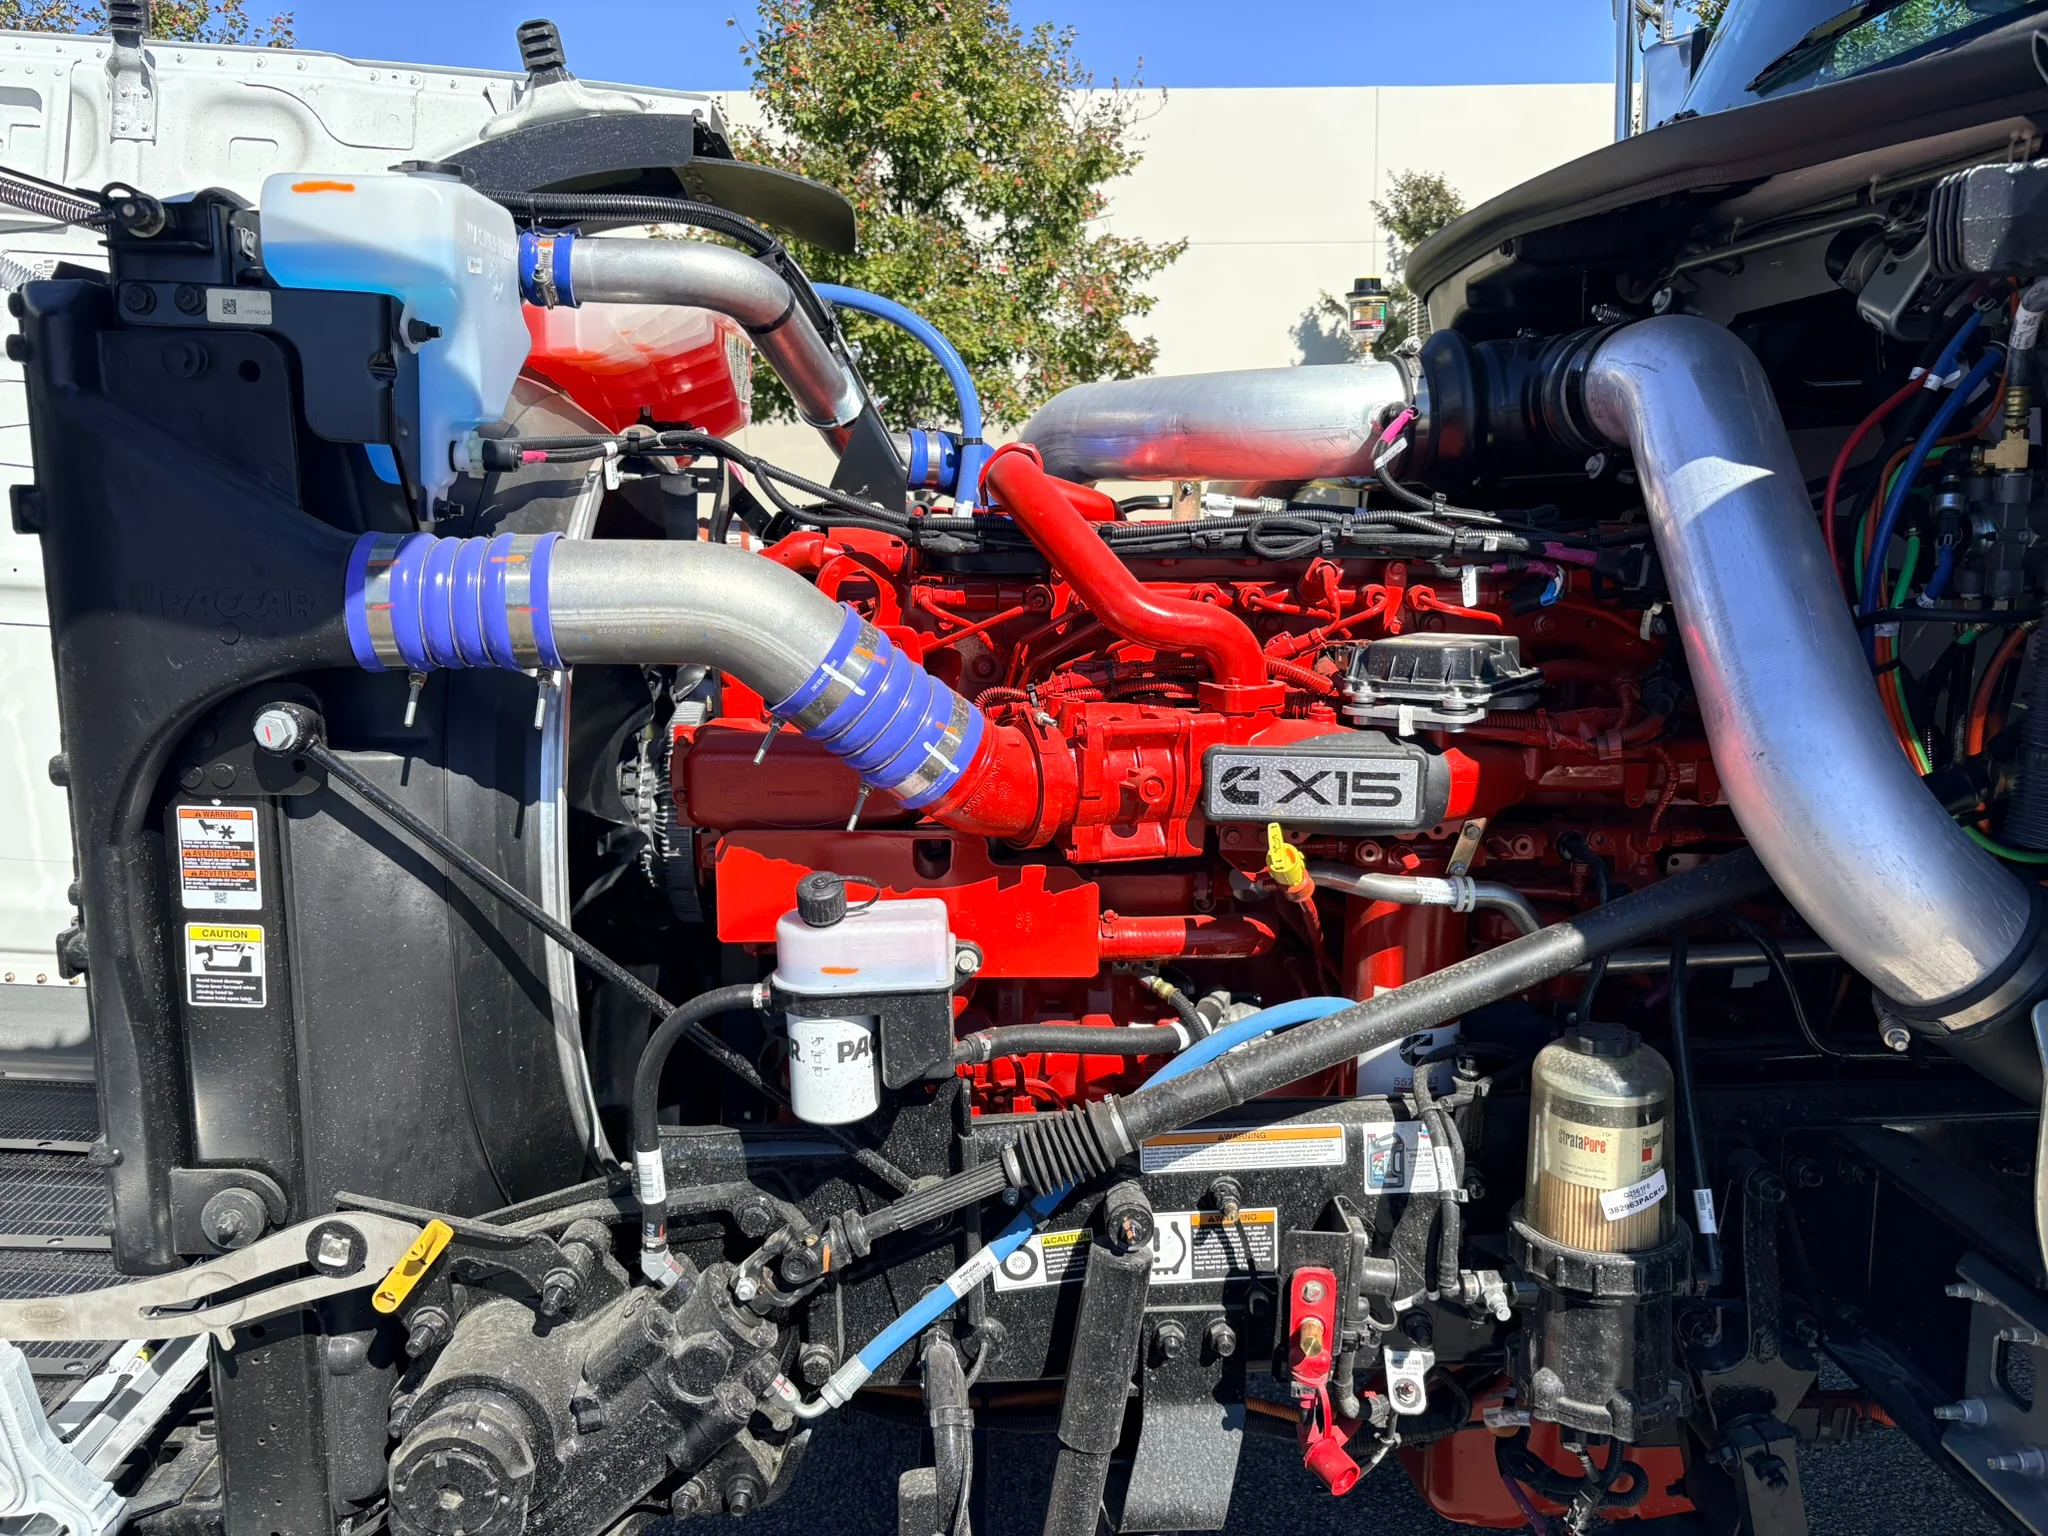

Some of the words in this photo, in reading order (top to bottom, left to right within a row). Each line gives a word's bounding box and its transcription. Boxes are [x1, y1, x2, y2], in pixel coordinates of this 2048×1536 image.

[963, 790, 986, 815] MADE
[983, 781, 994, 792] IN
[990, 756, 1006, 781] INDIA
[1220, 766, 1259, 791] Cummins
[1275, 769, 1403, 807] X15
[203, 811, 239, 819] WARNING
[193, 850, 252, 858] AVERTISSEMENT
[199, 870, 249, 878] ADVERTENCIA
[202, 930, 248, 938] CAUTION
[1400, 1033, 1432, 1055] Cummins
[1225, 1131, 1267, 1141] WARNING
[1558, 1129, 1606, 1153] StrataPore
[1624, 1183, 1651, 1199] Q2561F0
[1608, 1184, 1665, 1215] 382963PACR10
[1050, 1232, 1090, 1244] CAUTION
